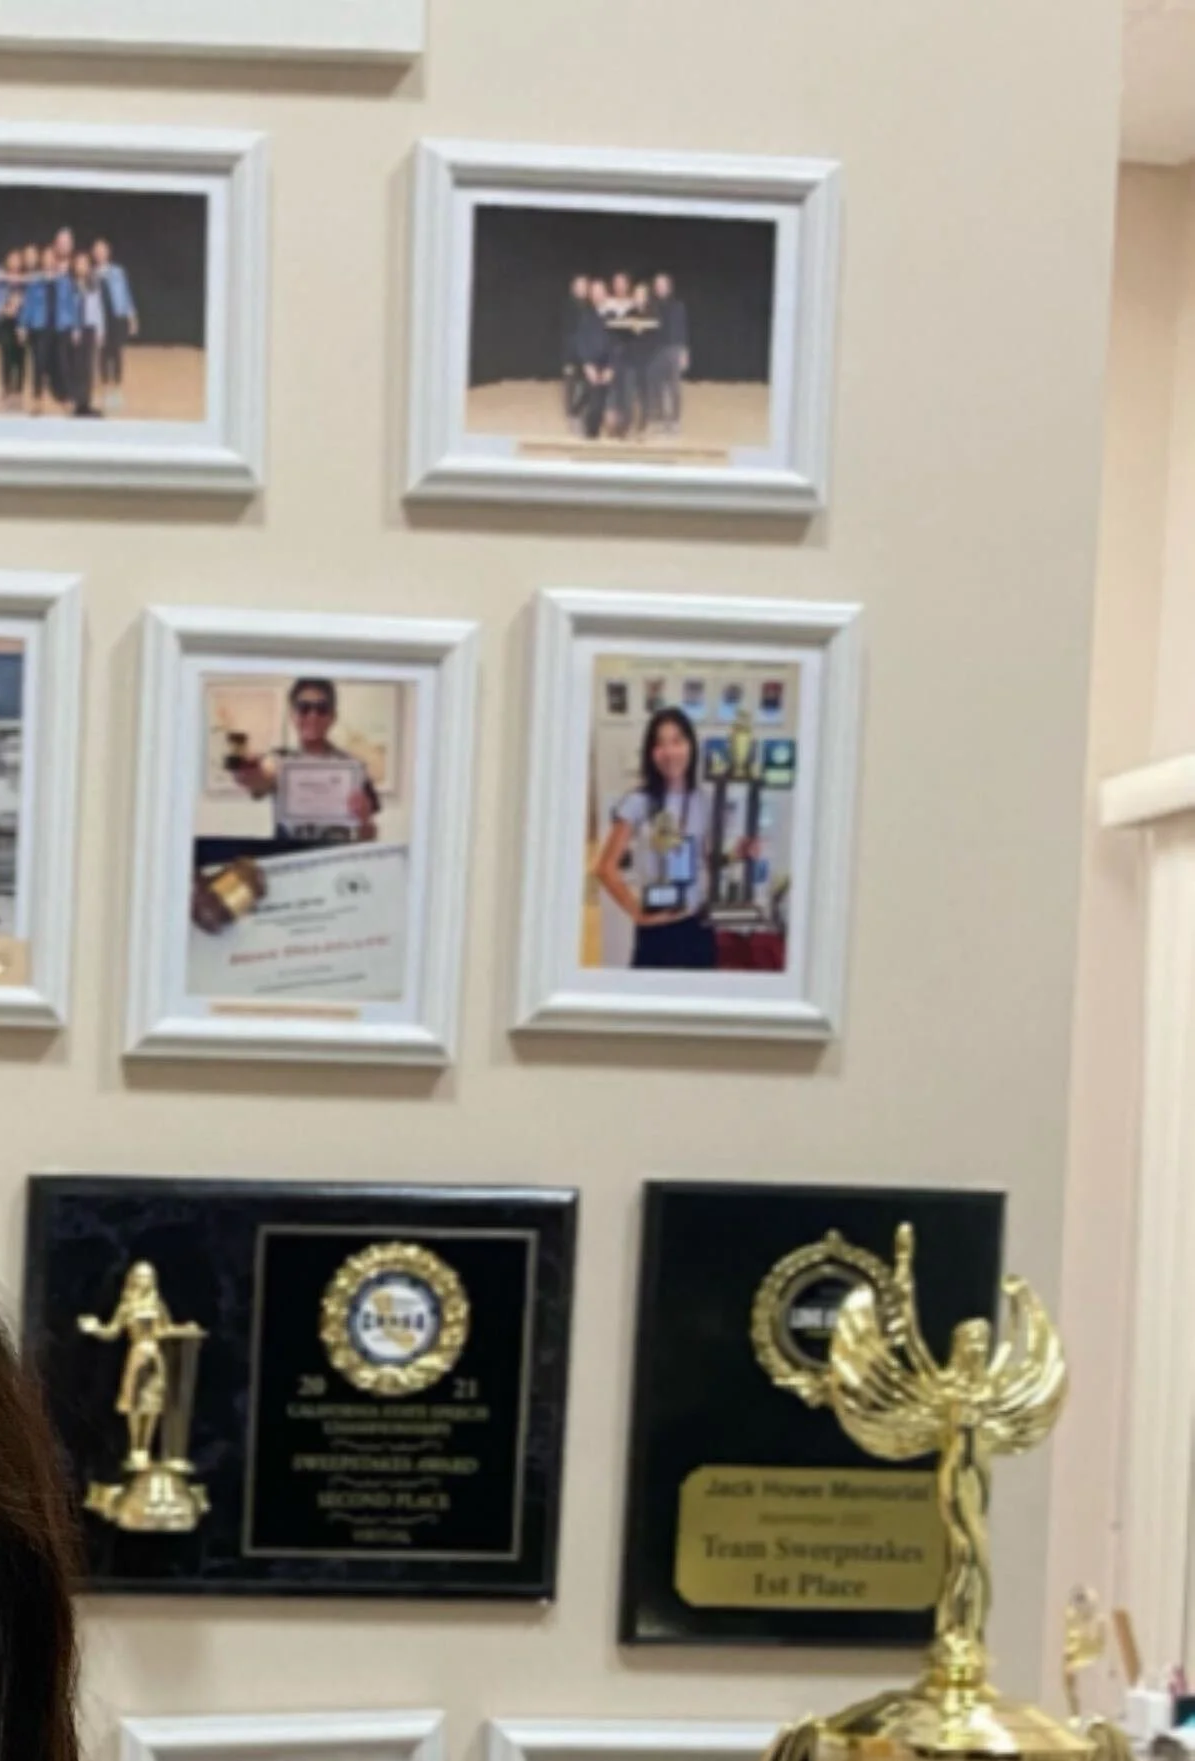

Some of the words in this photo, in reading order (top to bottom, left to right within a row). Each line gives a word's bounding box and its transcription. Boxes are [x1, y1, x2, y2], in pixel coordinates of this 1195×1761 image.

[297, 1376, 326, 1396] 20
[454, 1378, 478, 1399] 21
[706, 1477, 753, 1496] Jack
[761, 1480, 824, 1498] Howe
[704, 1535, 767, 1558] Team
[774, 1537, 924, 1568] Sweepstakes
[755, 1573, 789, 1596] 1st
[797, 1574, 866, 1597] Place
